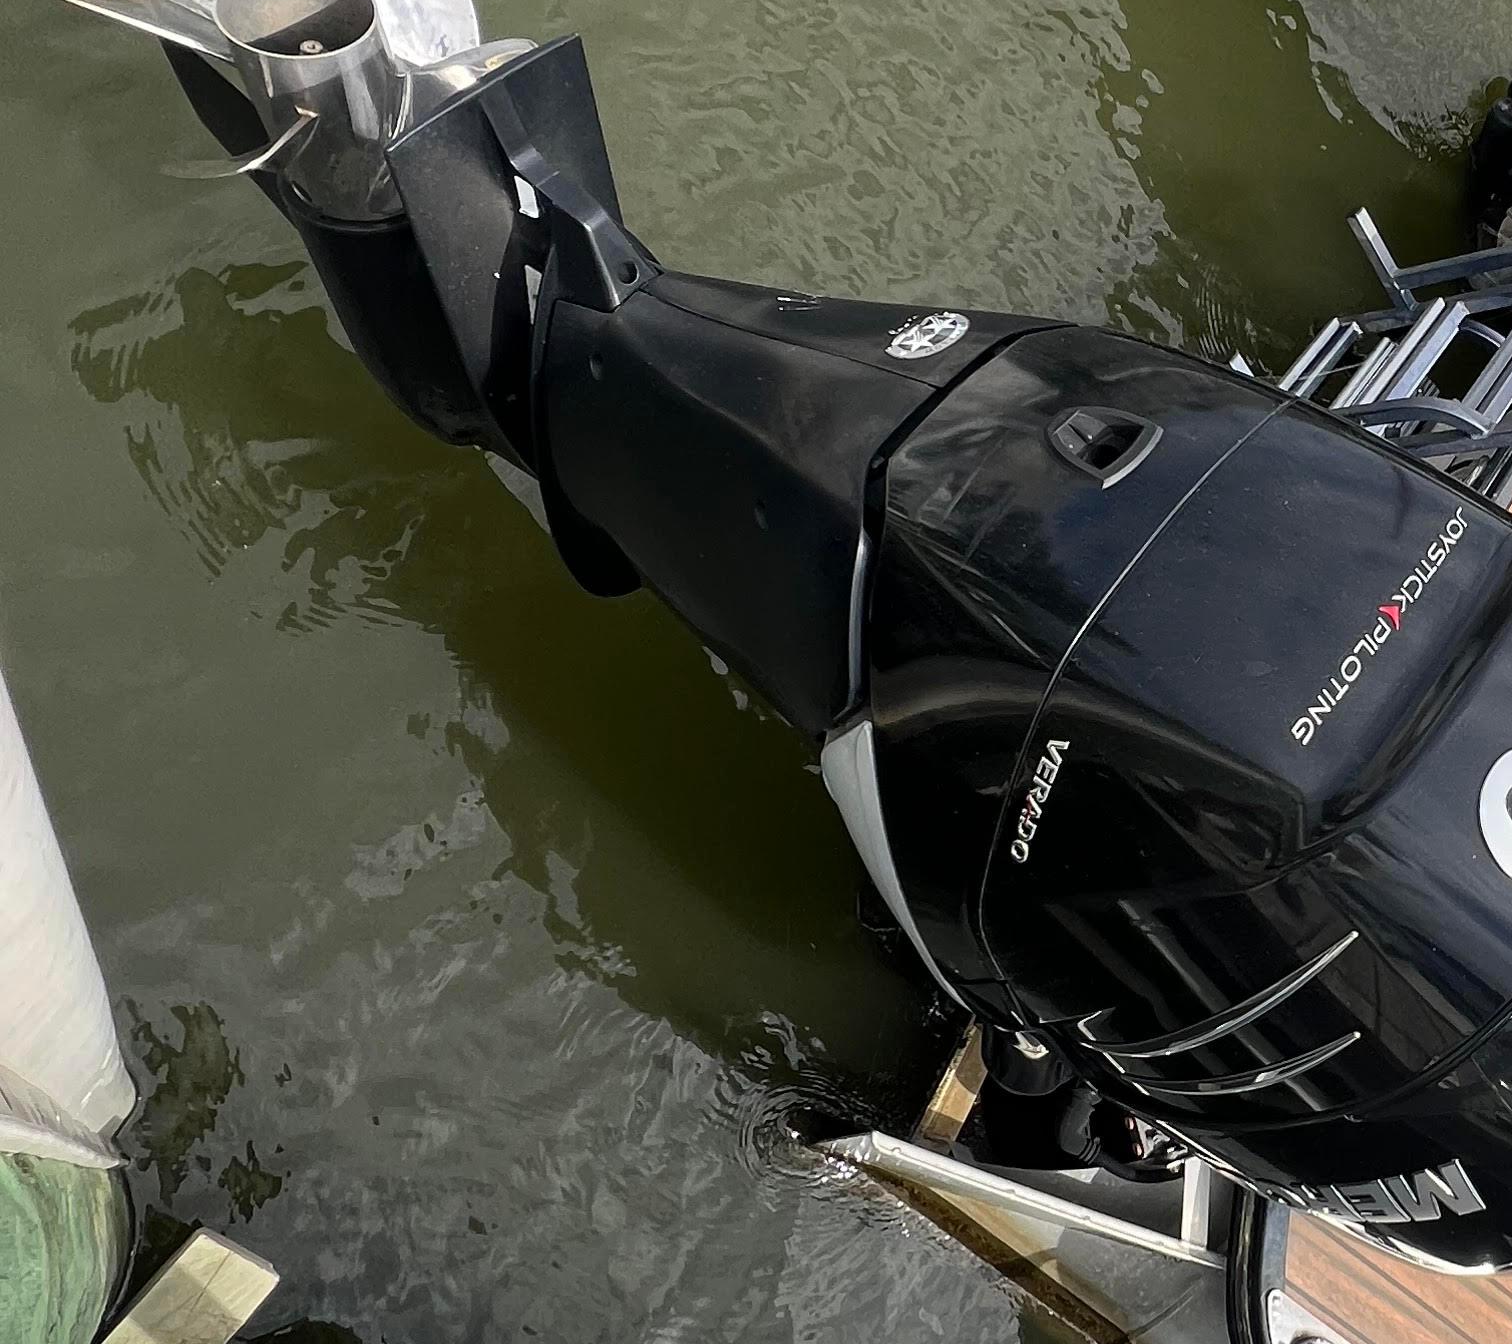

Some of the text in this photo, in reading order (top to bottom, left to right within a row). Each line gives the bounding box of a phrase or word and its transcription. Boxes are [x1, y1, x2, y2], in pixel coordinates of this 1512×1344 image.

[1291, 507, 1468, 745] JOYSTICK PILOTING
[1011, 739, 1070, 863] VERADO
